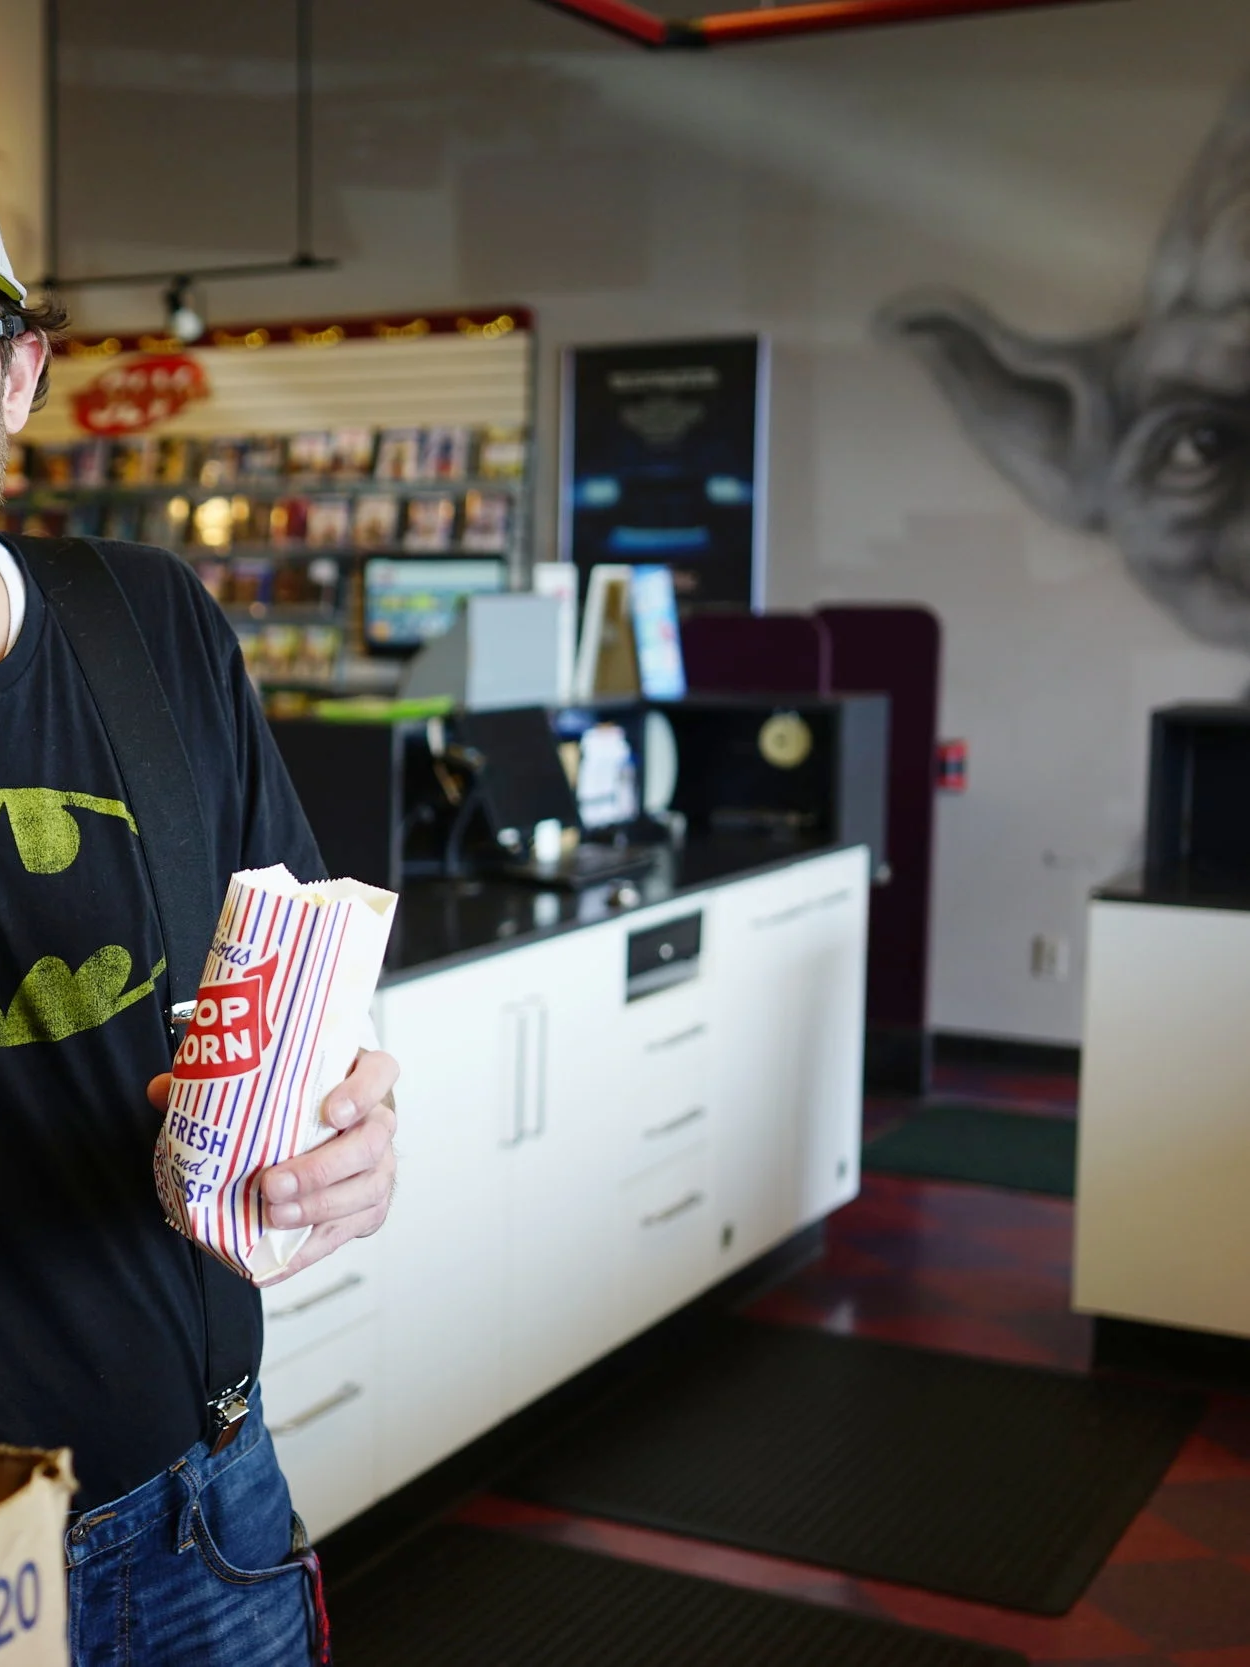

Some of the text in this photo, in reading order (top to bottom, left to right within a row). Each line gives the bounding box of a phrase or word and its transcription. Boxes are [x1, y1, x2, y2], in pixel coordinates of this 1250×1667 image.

[193, 996, 250, 1027] OP
[168, 1110, 229, 1158] FRESH
[173, 1152, 208, 1176] and
